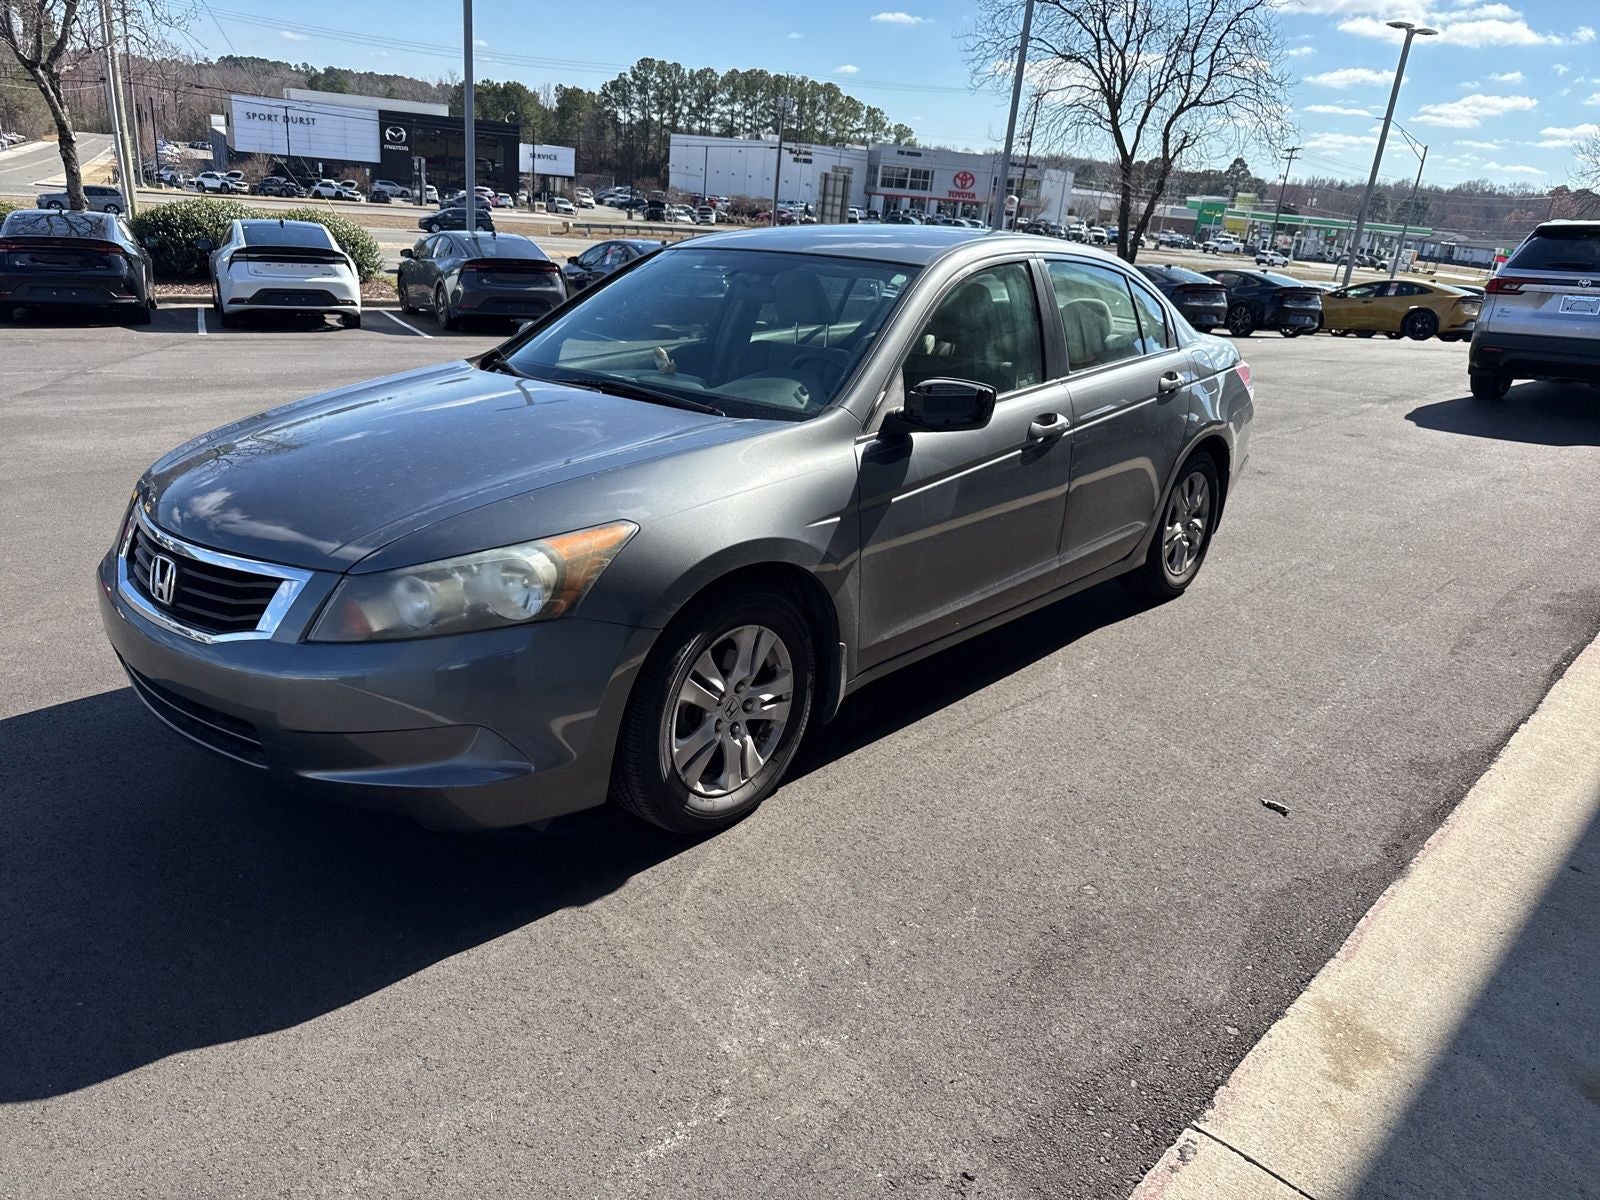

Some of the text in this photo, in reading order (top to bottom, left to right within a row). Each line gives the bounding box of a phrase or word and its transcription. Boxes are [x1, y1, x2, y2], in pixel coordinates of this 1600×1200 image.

[246, 112, 316, 125] SPORT DURST
[948, 190, 976, 199] TOYOTA
